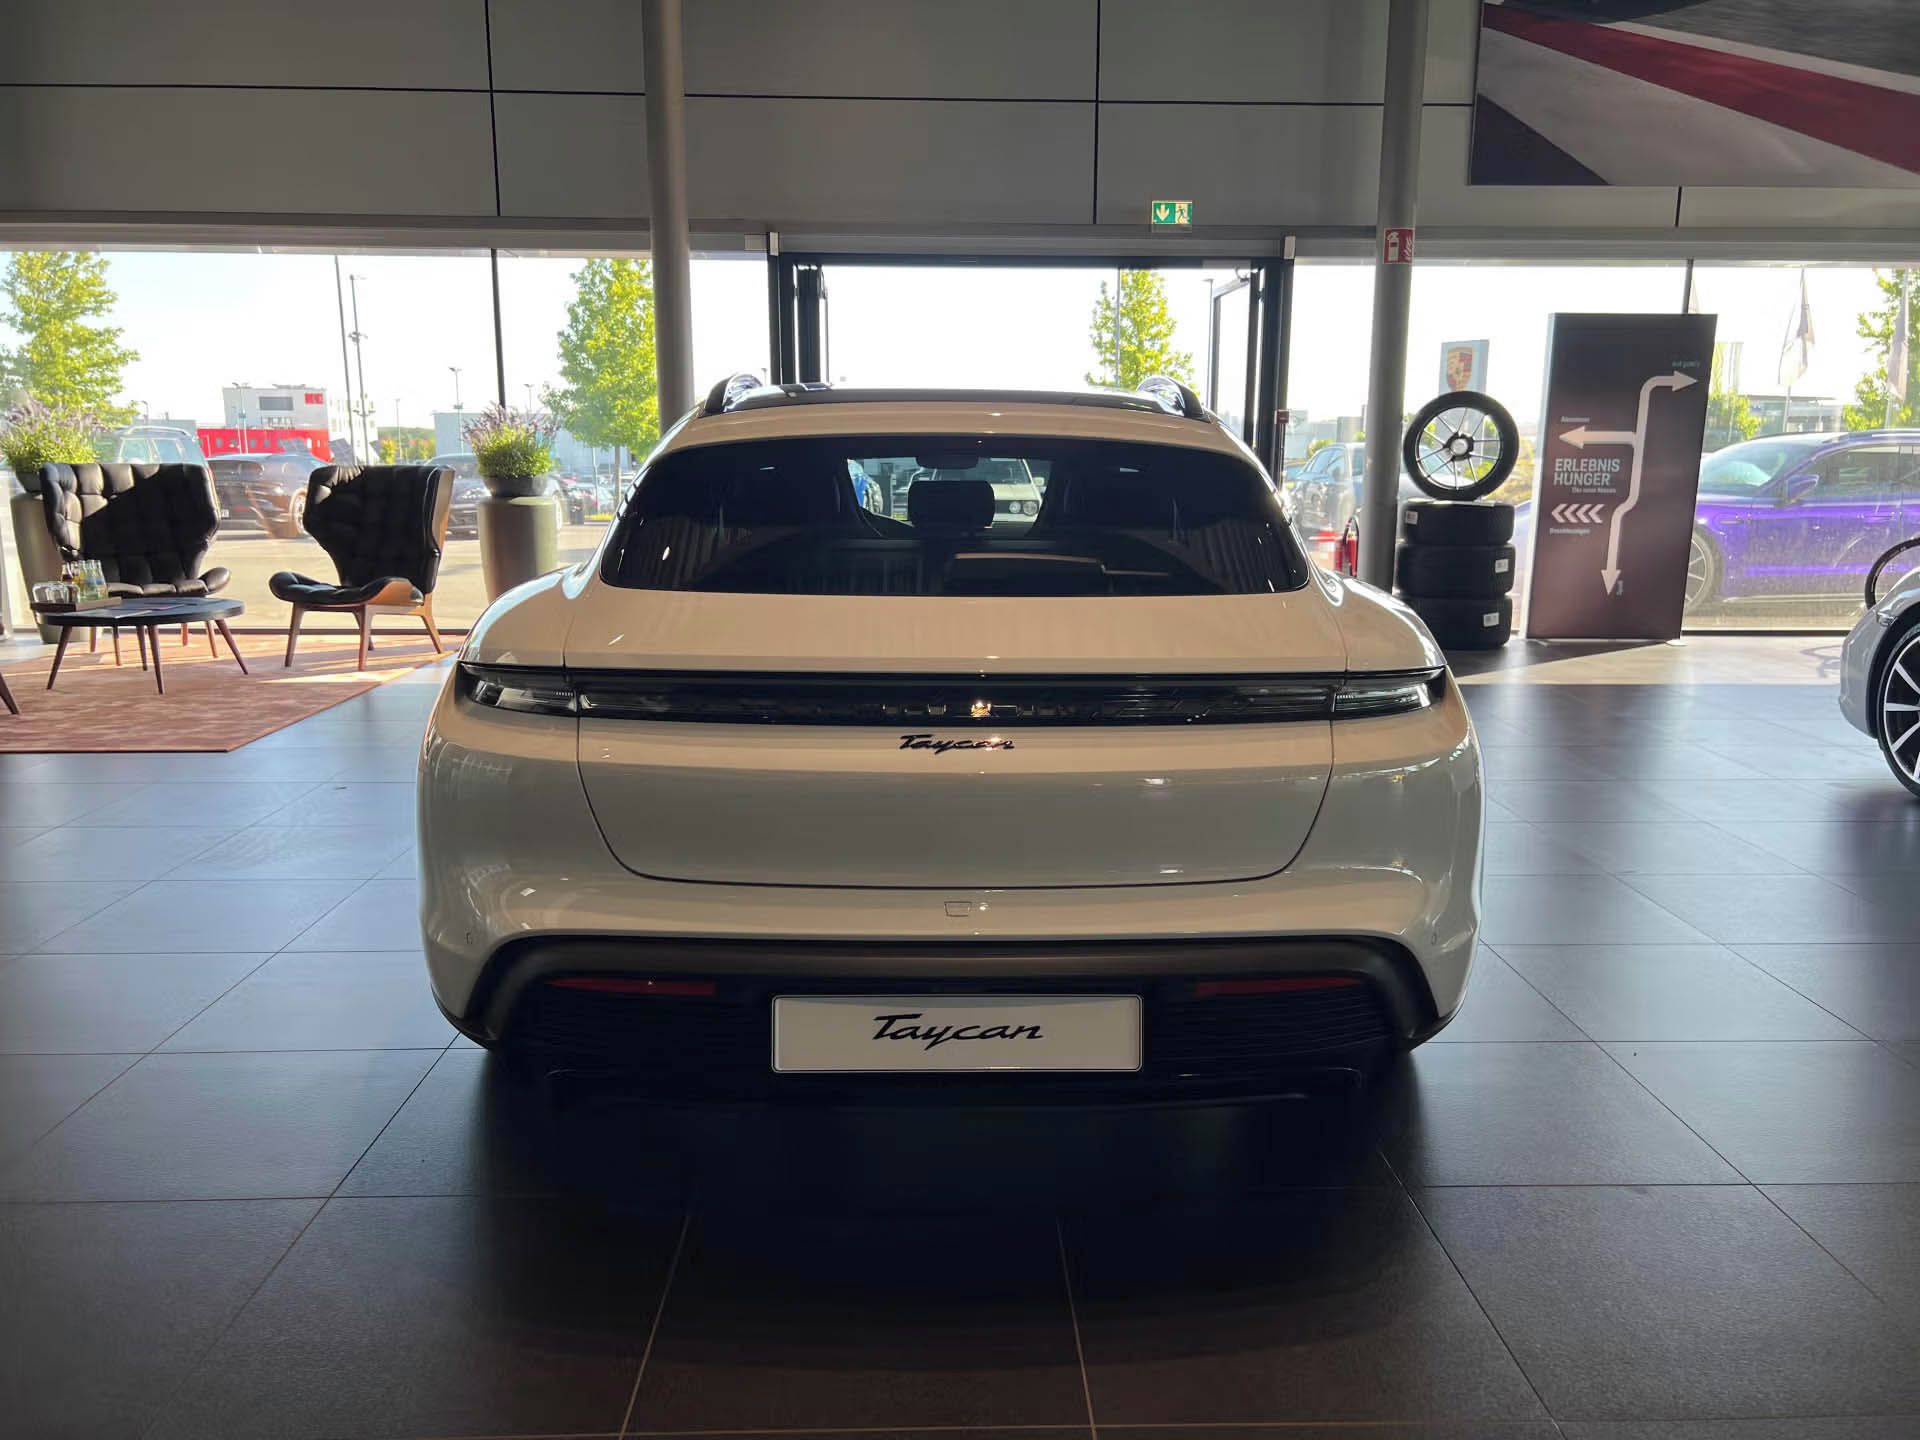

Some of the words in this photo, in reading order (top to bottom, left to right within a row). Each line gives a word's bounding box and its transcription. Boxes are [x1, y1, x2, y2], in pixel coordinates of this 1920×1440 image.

[1555, 458, 1620, 472] ERLEBNIS
[1553, 472, 1611, 486] HUNGER
[899, 733, 1015, 755] Taycan
[872, 1013, 1044, 1051] Taycan
